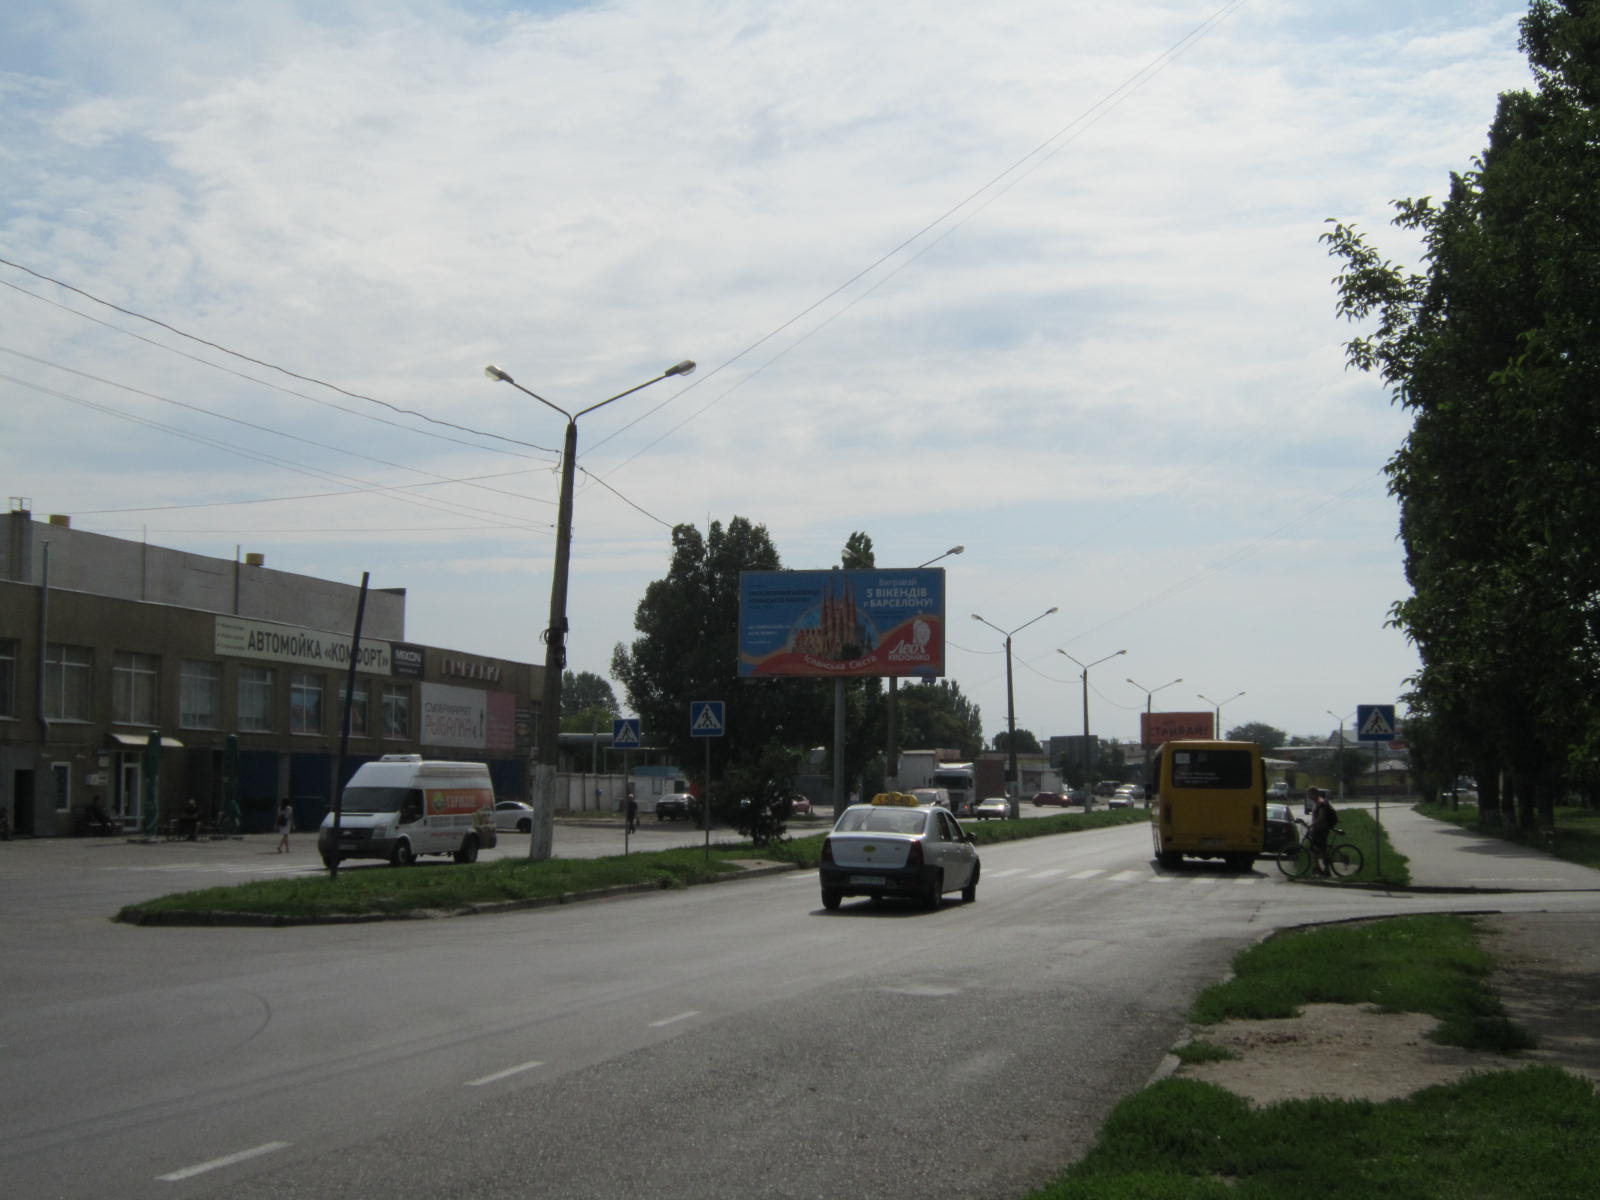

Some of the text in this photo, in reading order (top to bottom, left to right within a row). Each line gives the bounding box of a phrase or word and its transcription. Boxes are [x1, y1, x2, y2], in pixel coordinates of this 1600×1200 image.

[866, 587, 928, 599] 5 ВІКЕНДІВ
[247, 628, 323, 660] АВТОМОЙКА
